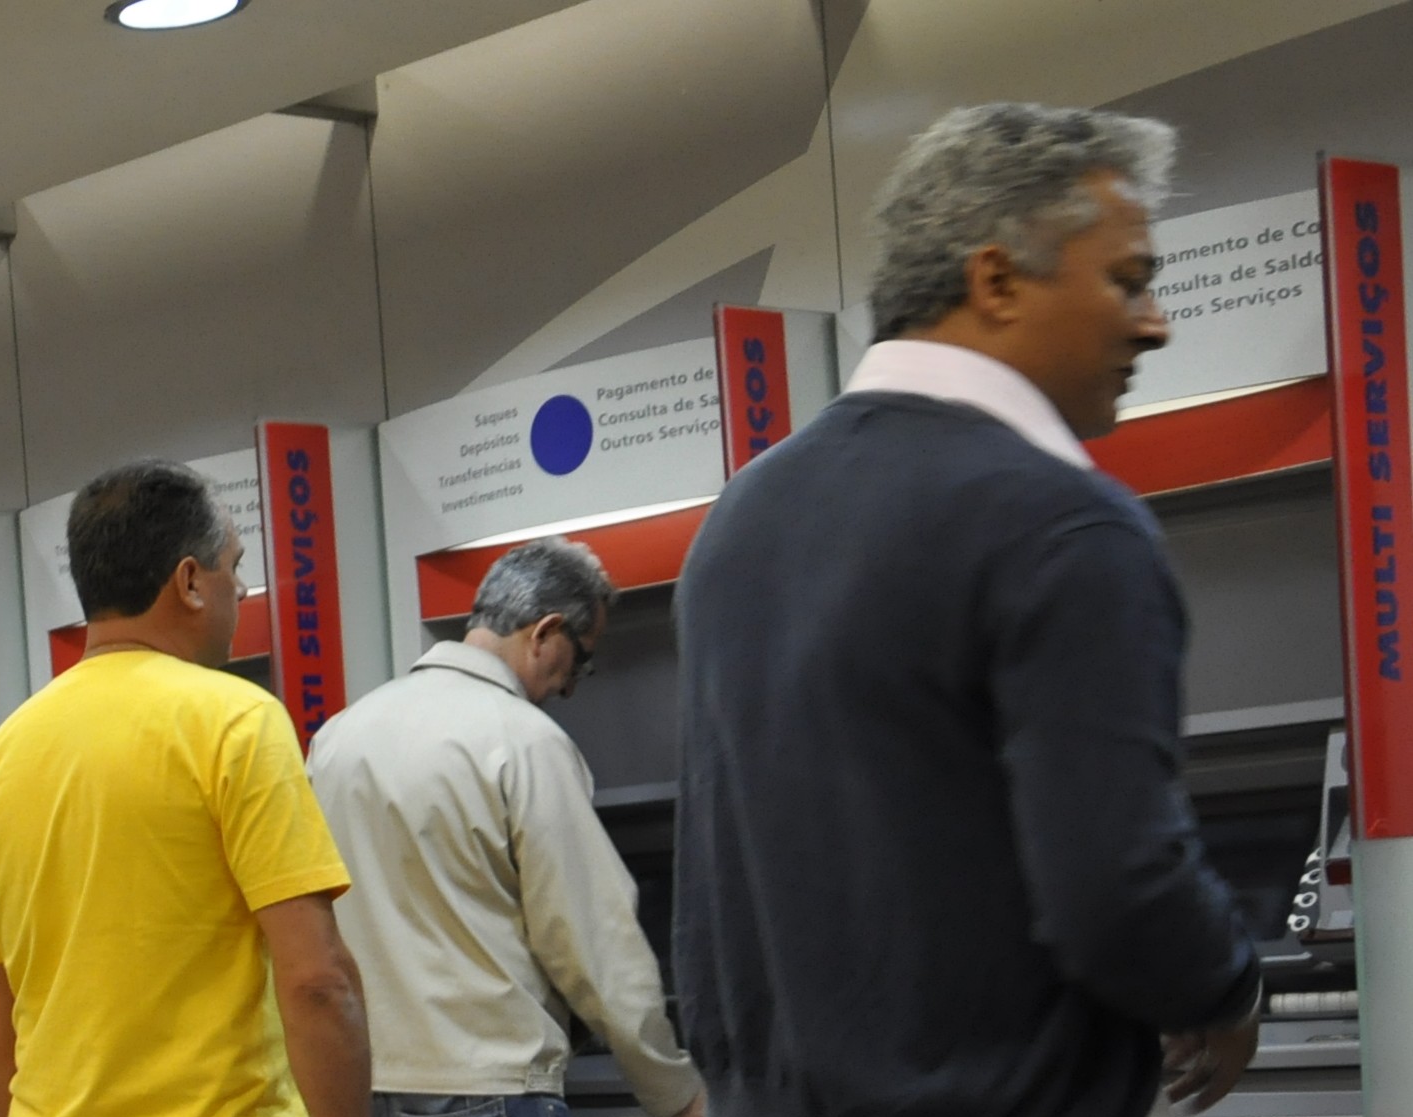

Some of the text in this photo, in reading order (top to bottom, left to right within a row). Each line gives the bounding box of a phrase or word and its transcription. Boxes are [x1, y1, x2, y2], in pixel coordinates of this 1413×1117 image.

[1153, 219, 1322, 272] gamento de Co
[1151, 272, 1222, 299] nsulta
[1230, 264, 1257, 282] de
[1162, 282, 1304, 324] tros Serviços
[596, 366, 716, 404] Pagamento de
[743, 337, 775, 459] IÇOS
[474, 405, 519, 429] Saques
[598, 393, 720, 428] Consulta de Sa
[459, 430, 520, 459] Depósitos
[600, 416, 721, 453] Outros Serviço
[1355, 201, 1403, 682] MULTI SERVIÇOS
[438, 455, 523, 490] Transferências
[441, 480, 524, 515] Investimentos
[287, 448, 321, 657] SERVIÇOS
